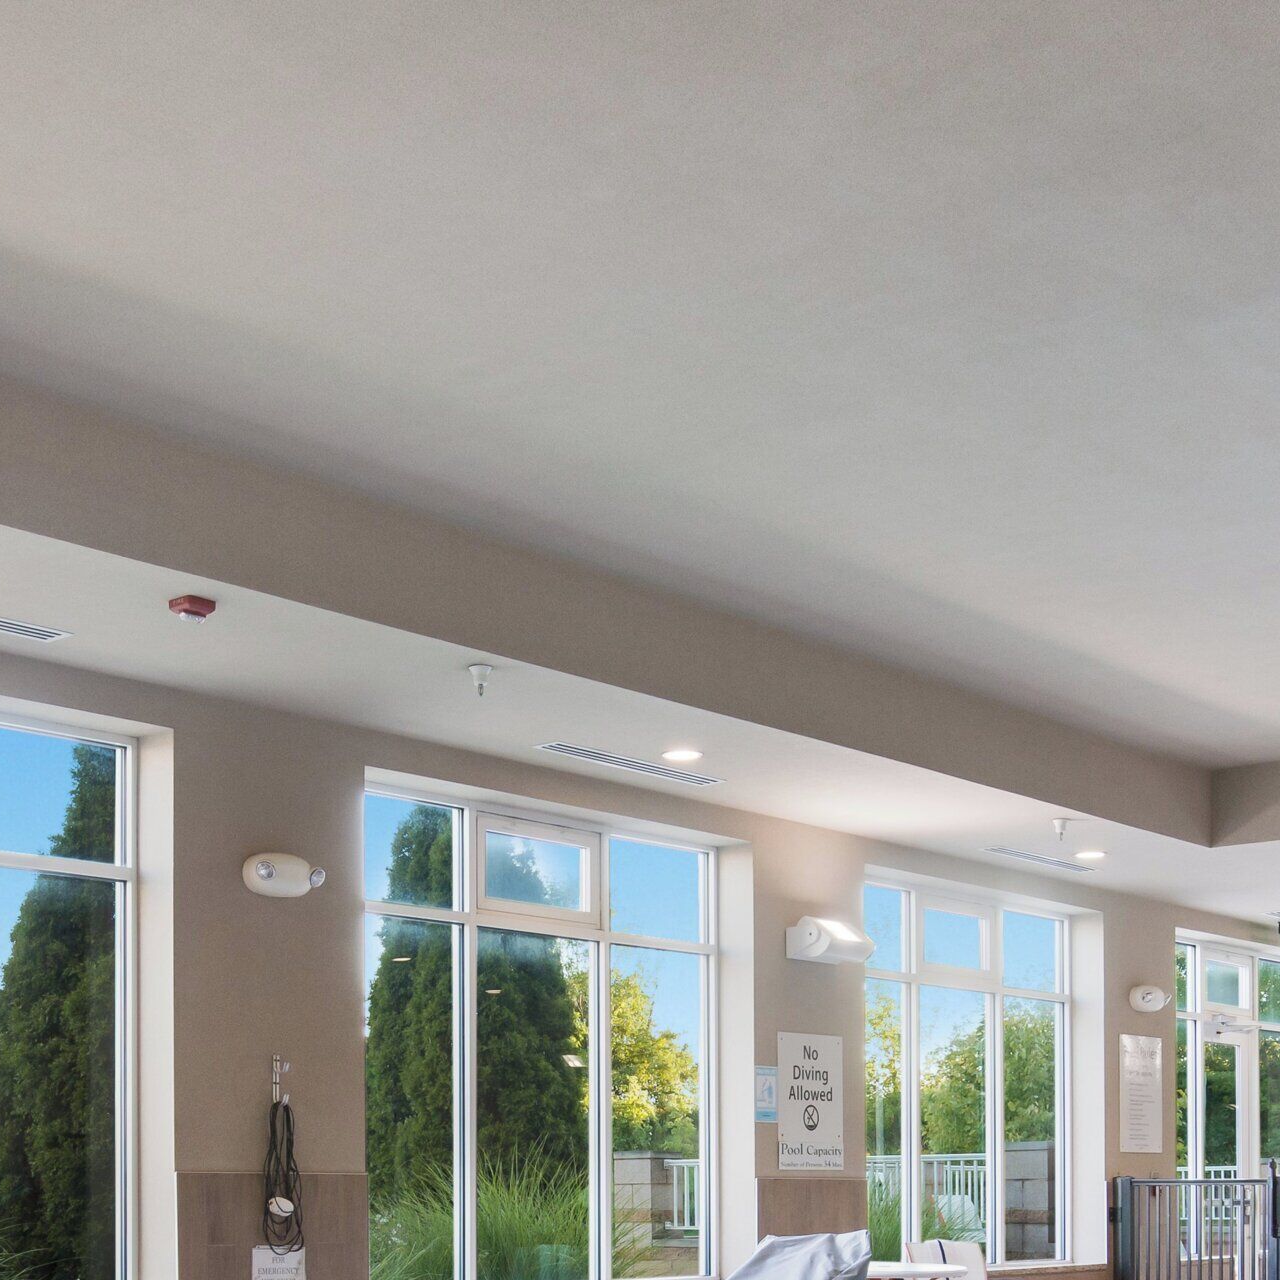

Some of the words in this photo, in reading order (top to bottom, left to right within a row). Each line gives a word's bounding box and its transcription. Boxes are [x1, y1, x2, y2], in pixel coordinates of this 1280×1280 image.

[803, 1045, 819, 1061] No
[792, 1065, 829, 1085] Diving
[788, 1085, 833, 1102] Allowed
[781, 1142, 803, 1155] Pool
[806, 1144, 843, 1158] Capacity
[272, 1256, 286, 1264] FOR
[257, 1267, 299, 1275] EMERGENCY
